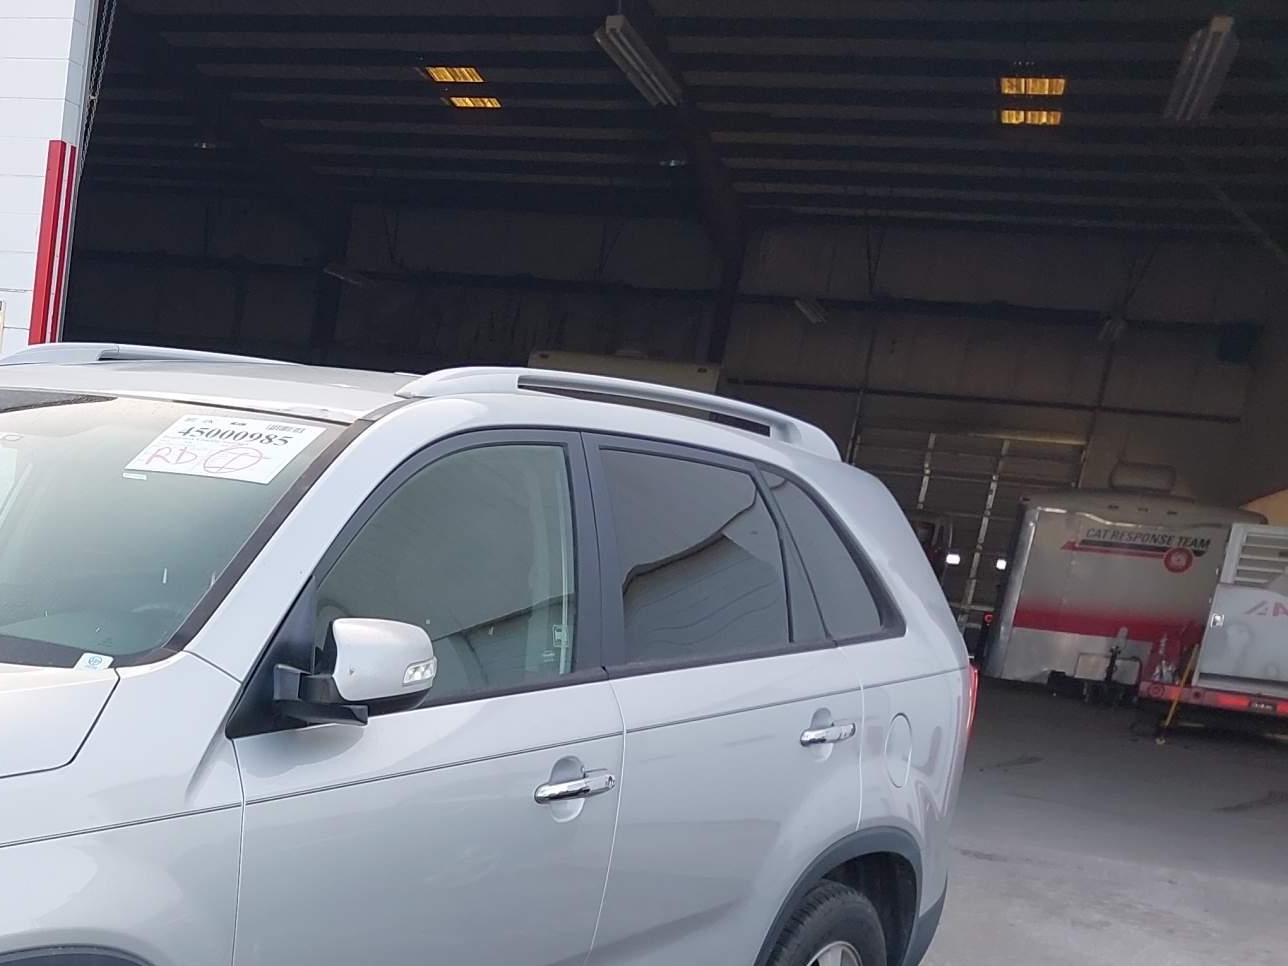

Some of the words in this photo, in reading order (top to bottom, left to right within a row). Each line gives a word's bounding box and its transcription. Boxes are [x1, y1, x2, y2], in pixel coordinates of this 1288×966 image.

[178, 426, 293, 447] 45000985
[1086, 528, 1112, 539] CAT
[1111, 530, 1177, 546] RESPONSE
[1177, 536, 1211, 549] TEAM
